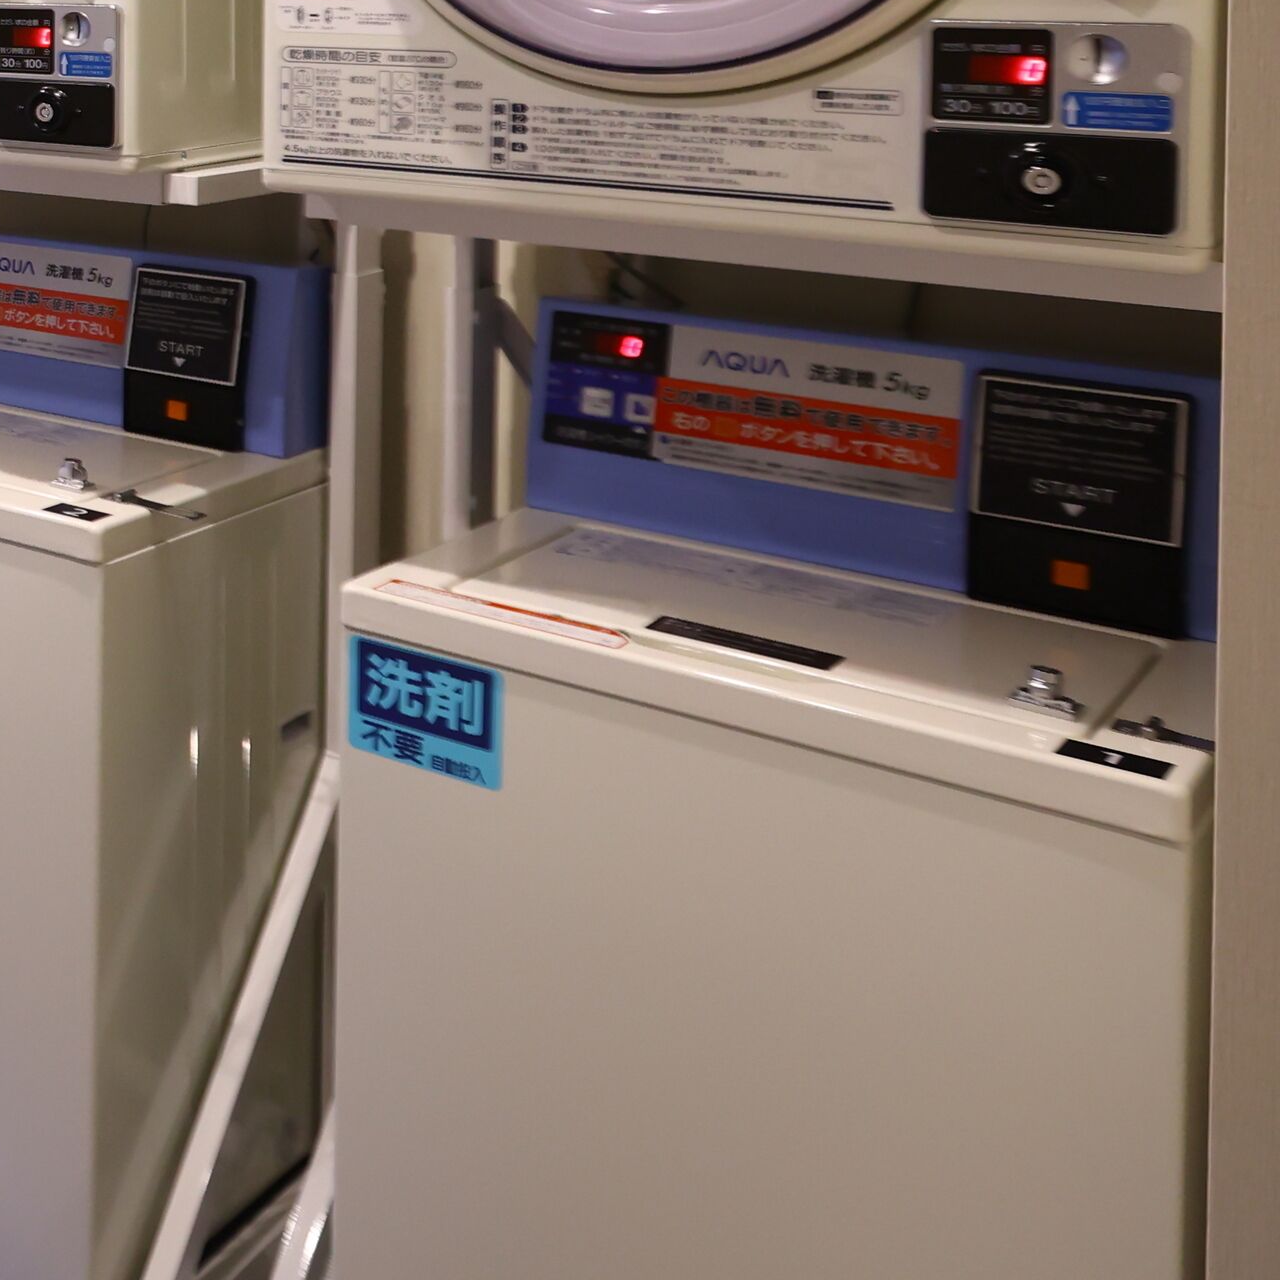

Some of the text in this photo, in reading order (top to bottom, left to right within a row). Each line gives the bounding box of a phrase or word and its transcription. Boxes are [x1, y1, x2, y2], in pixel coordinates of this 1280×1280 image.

[289, 48, 382, 63] 乾燥時間の目安
[45, 263, 114, 288] 洗濯機 5kg
[159, 340, 205, 357] START
[700, 348, 790, 378] AQUA
[883, 371, 931, 401] 5kg
[671, 411, 711, 432] 右の
[1031, 477, 1119, 504] START
[61, 507, 89, 518] 2
[366, 652, 486, 737] 洗剤
[361, 719, 425, 766] 不要
